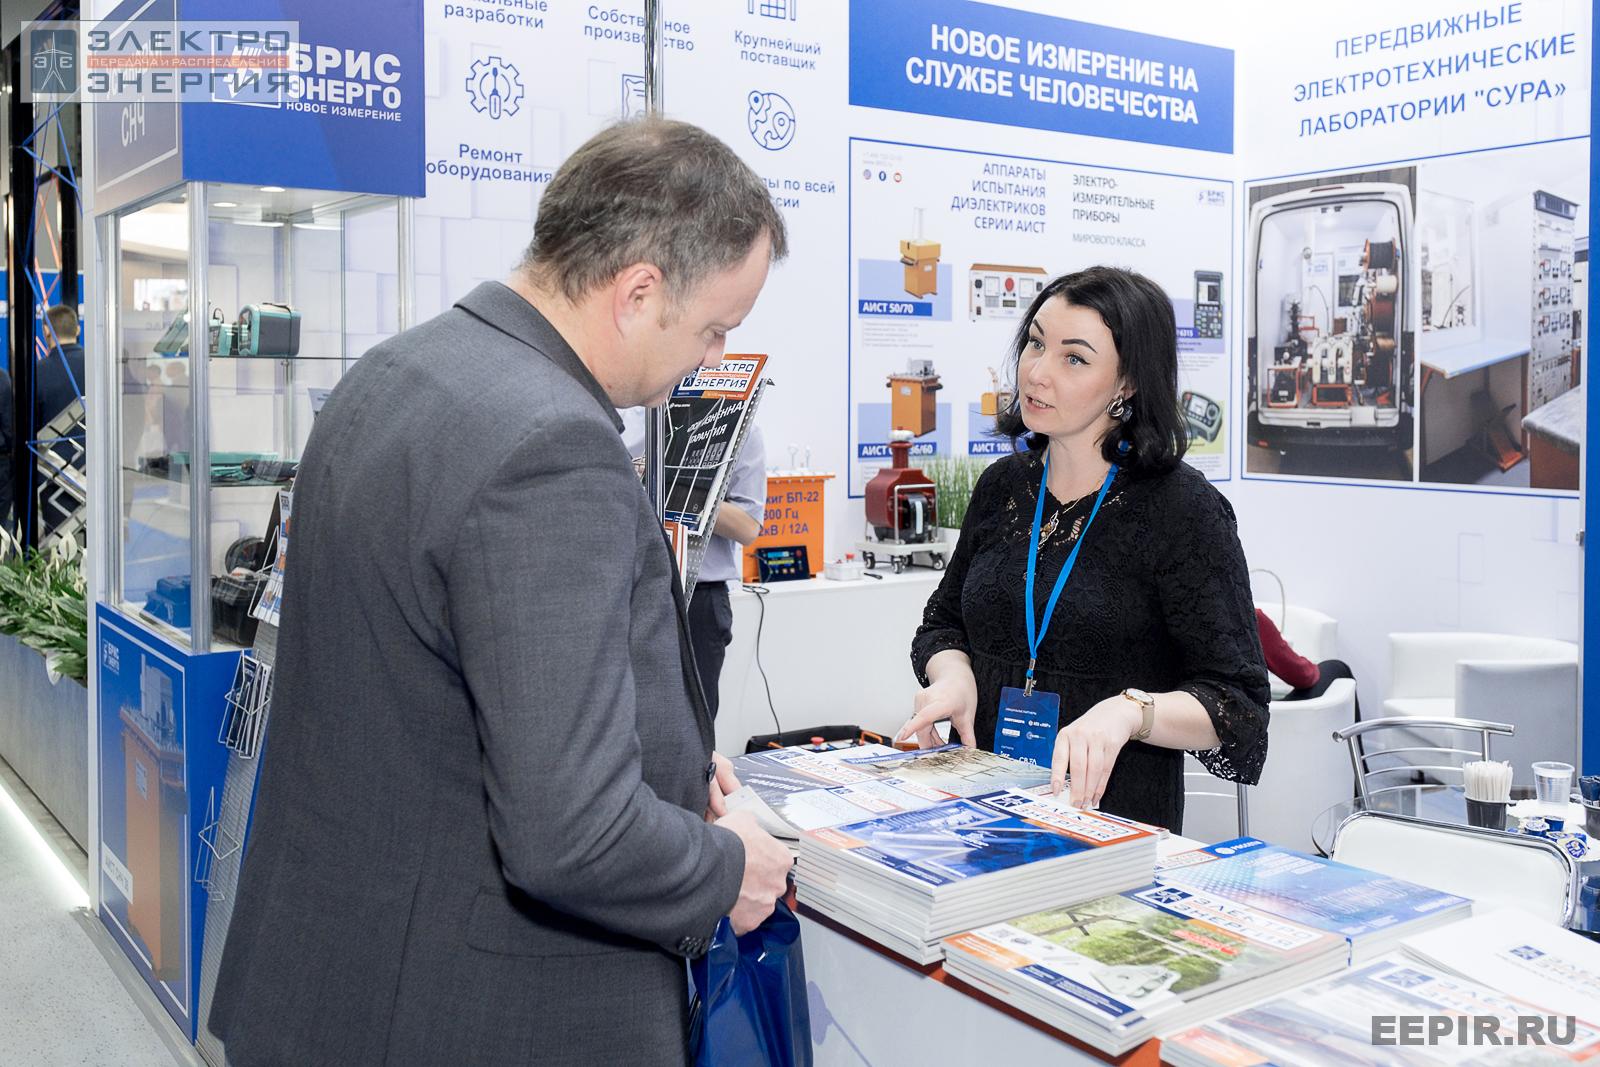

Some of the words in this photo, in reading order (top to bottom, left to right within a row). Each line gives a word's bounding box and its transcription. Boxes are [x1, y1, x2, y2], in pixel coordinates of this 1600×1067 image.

[444, 4, 544, 29] разработки
[588, 5, 690, 34] Собствное
[584, 25, 694, 51] произвтво
[1335, 2, 1523, 59] ПЕРЕДВИЖНЫЕ
[734, 30, 822, 55] Крупнейший
[286, 41, 401, 84] БРИС
[740, 50, 817, 71] поставщик
[931, 23, 1021, 64] НОВОЕ
[1027, 40, 1164, 87] ИЗМЕРЕНИЕ
[1169, 64, 1199, 93] НА
[1294, 33, 1576, 102] ЭЛЕКТРОТЕХНИЧЕСКИЕ
[288, 75, 402, 109] ЭНЕРГО
[905, 56, 1013, 97] СЛУЖБЕ
[1020, 73, 1199, 124] ЧЕЛОВЕЧЕСТВА
[121, 95, 145, 147] СНЧ
[287, 102, 328, 114] НОВОЕ
[331, 106, 402, 121] ИЗМЕРЕНИЕ
[1299, 92, 1467, 137] ЛАБОРАТОРИИ
[459, 143, 523, 163] Ремонт
[426, 160, 552, 183] оборудования
[983, 162, 1046, 181] АППАРАТЫ
[1073, 174, 1119, 189] ЭЛЕКТРО-
[784, 180, 800, 191] по
[804, 181, 835, 193] всей
[972, 180, 1046, 198] ИСПЫТАНИЯ
[951, 196, 1046, 216] ДИЭЛЕКТРИКОВ
[1073, 192, 1155, 210] ИЗМЕРИТЕЛЬНЫЕ
[974, 216, 1013, 231] СЕРИИ
[1016, 220, 1046, 234] АИСТ
[1073, 208, 1120, 223] ПРИБОРЫ
[863, 302, 887, 313] АИСТ
[889, 303, 914, 314] 50/70
[695, 379, 748, 388] ЭНЕРГИЯ
[862, 445, 887, 456] АИСТ
[972, 443, 994, 452] АИСТ
[786, 491, 819, 503] БП-22
[785, 508, 799, 519] Гц
[790, 523, 809, 535] 12А
